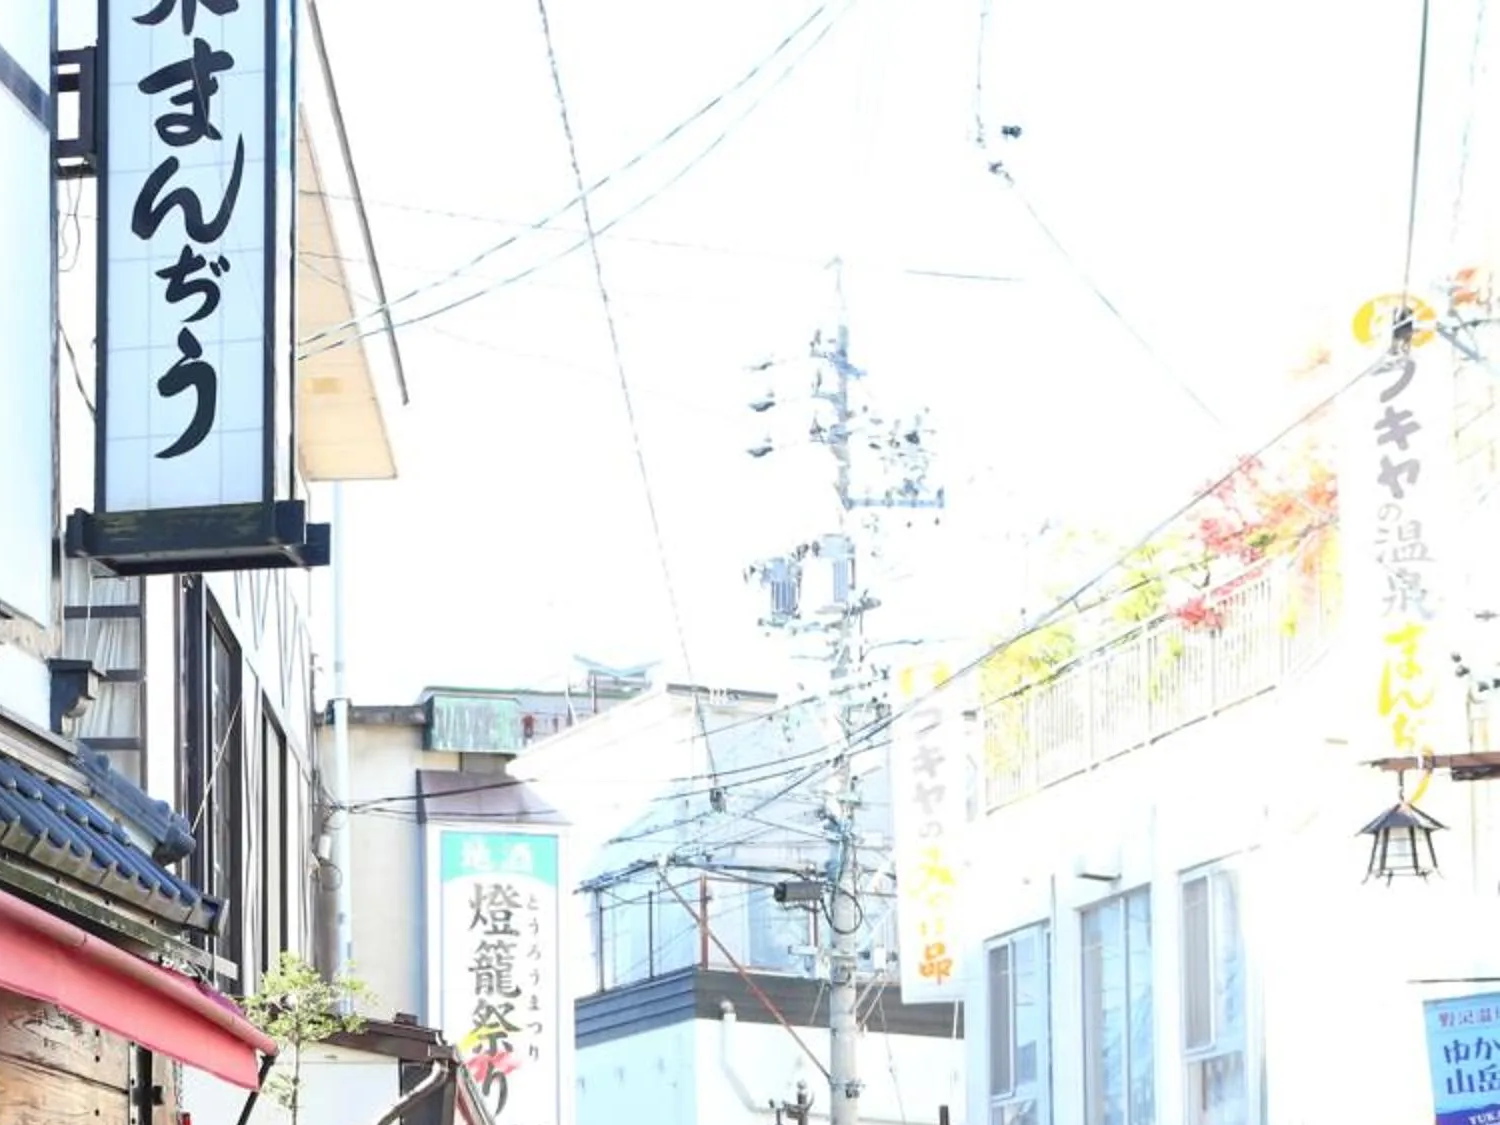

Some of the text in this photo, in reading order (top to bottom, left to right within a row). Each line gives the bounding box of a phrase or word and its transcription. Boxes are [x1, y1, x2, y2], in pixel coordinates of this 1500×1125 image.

[467, 882, 524, 1119] 燈籠祭り
[525, 892, 544, 1063] とうろうまつり
